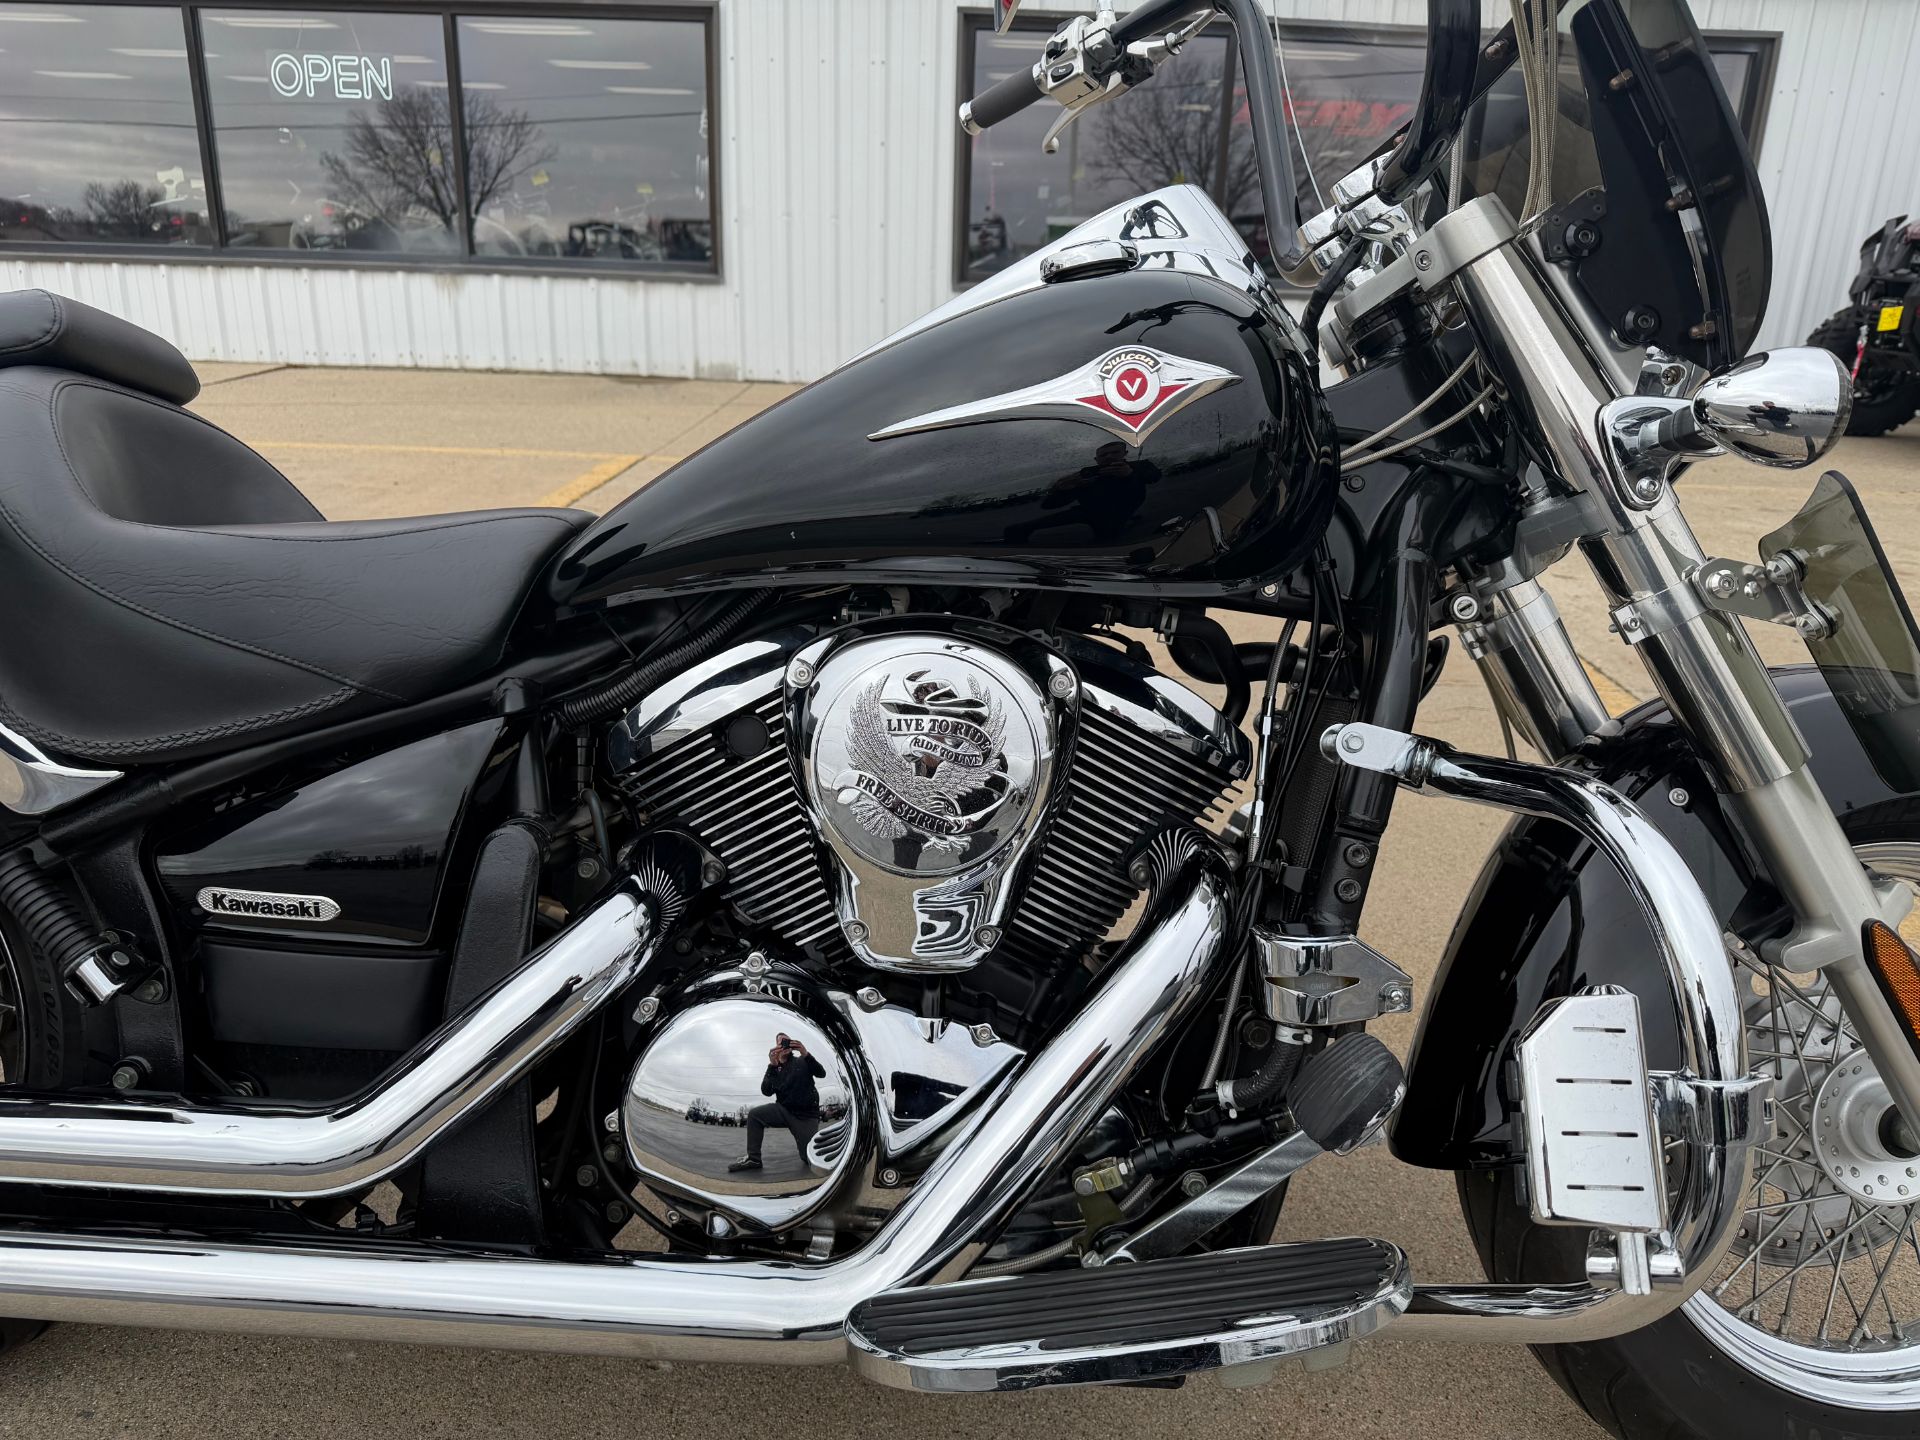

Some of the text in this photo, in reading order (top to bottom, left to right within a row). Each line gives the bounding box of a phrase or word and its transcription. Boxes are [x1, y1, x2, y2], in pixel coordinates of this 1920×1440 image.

[271, 54, 393, 100] OPEN
[1121, 377, 1143, 397] V
[887, 718, 992, 753] LIVE TO RIDE
[913, 737, 940, 752] RIDE
[940, 747, 956, 761] TO
[856, 774, 951, 834] FREE SPIRIT
[212, 893, 321, 918] Kawasaki
